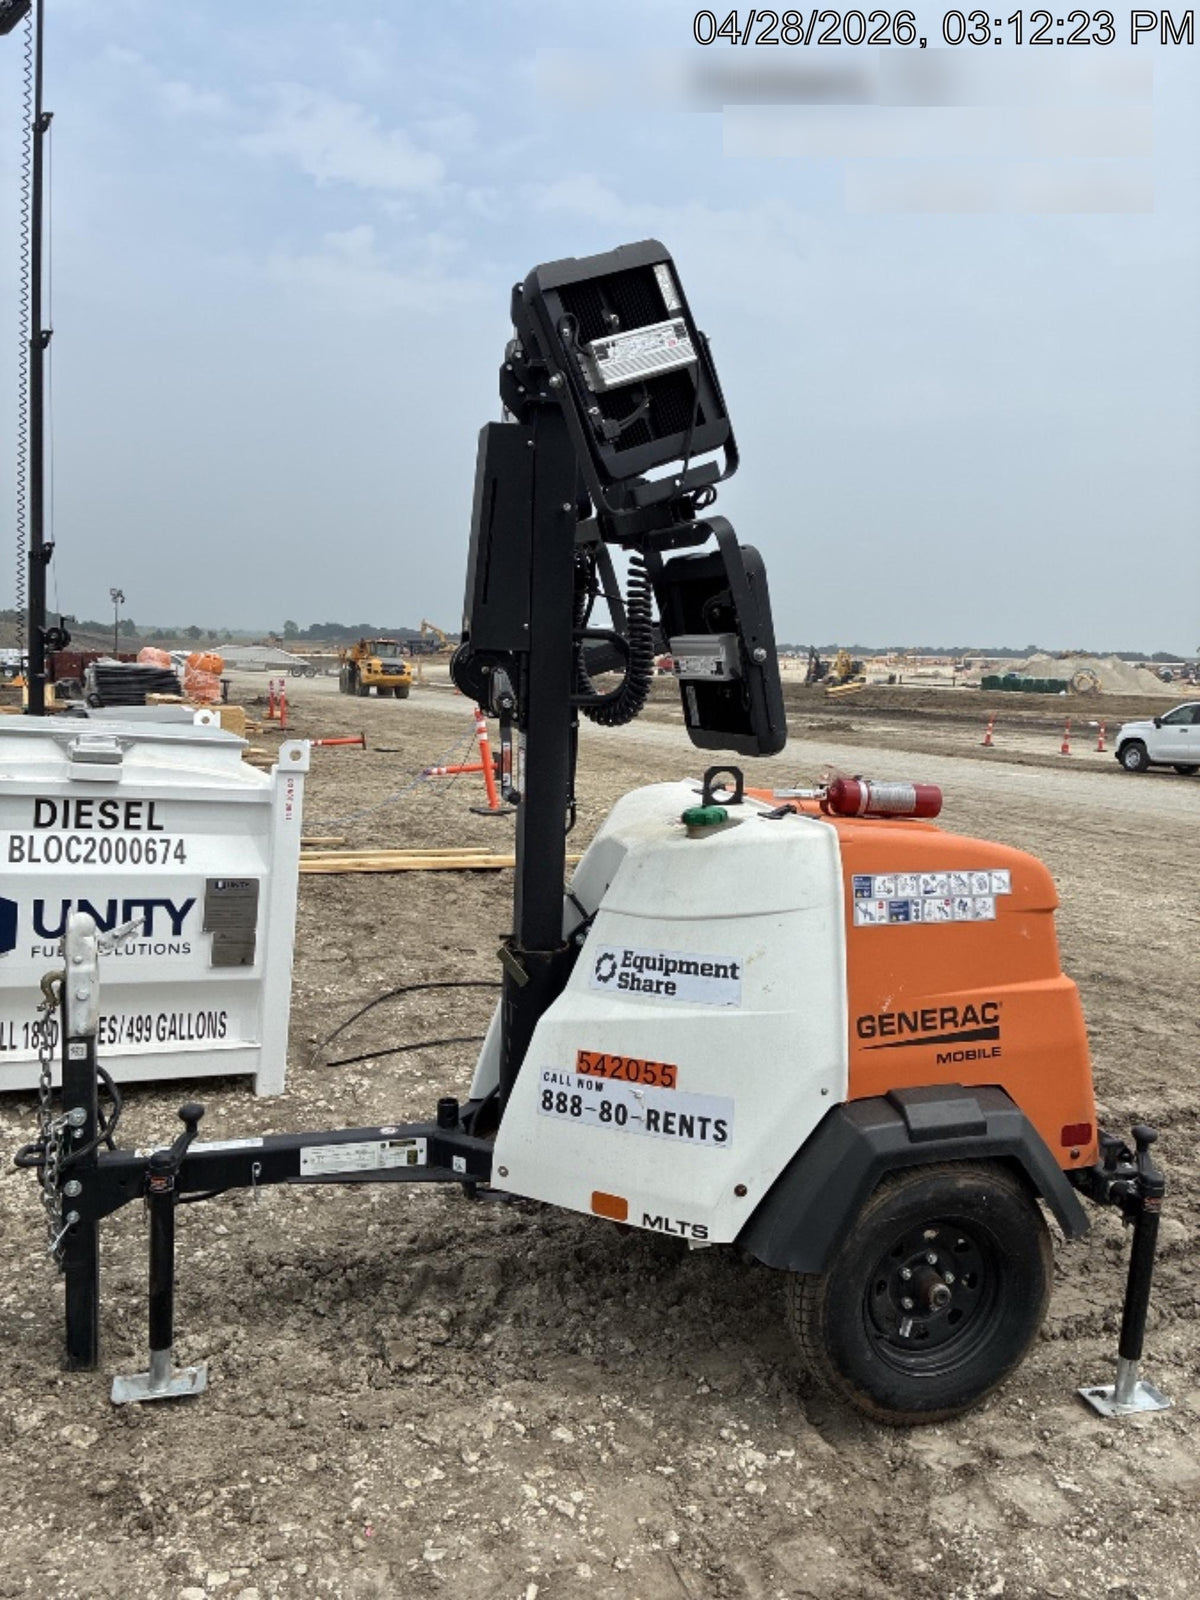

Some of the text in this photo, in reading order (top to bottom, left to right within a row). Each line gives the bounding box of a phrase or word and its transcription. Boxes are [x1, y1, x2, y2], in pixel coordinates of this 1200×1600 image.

[33, 798, 164, 831] DIESEL
[8, 834, 187, 865] BLOC2000674
[33, 898, 197, 939] UNITY
[31, 942, 192, 959] FUE LUTIONS
[620, 949, 741, 980] Equipment
[617, 971, 677, 997] Share
[156, 1010, 228, 1042] GALLONS
[856, 1001, 1001, 1040] GENERAC
[577, 1050, 675, 1089] 542055
[936, 1046, 1002, 1065] MOBILE
[543, 1071, 604, 1092] CALL NOW
[541, 1088, 728, 1143] 888-80-RENTS
[642, 1213, 709, 1240] MLTS
